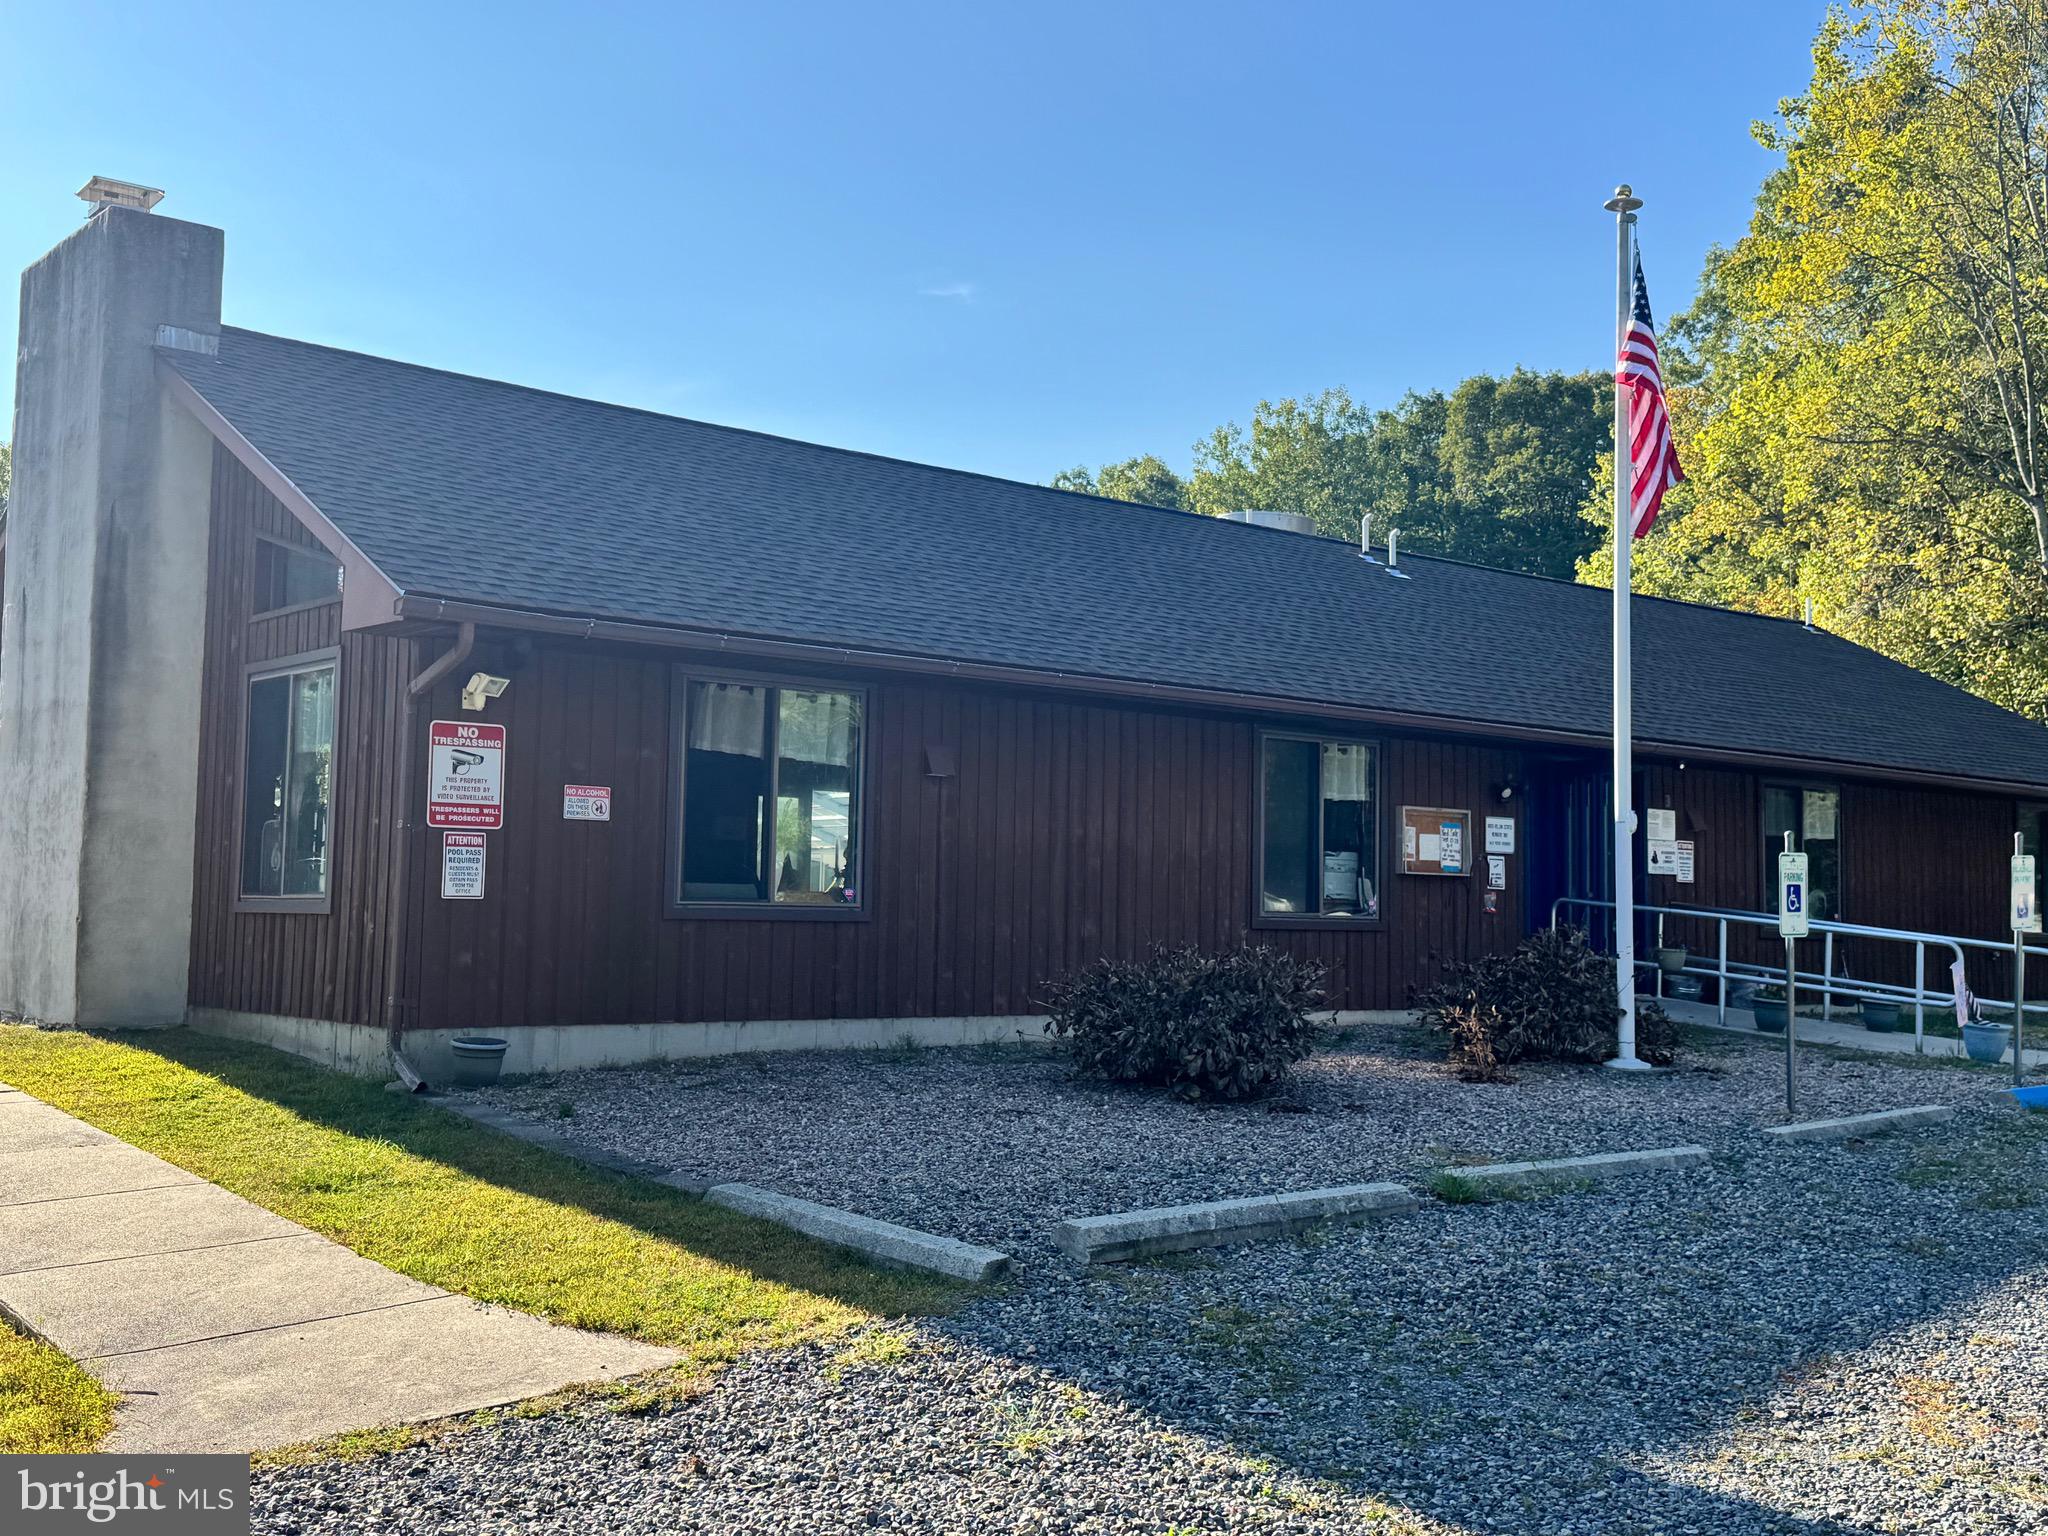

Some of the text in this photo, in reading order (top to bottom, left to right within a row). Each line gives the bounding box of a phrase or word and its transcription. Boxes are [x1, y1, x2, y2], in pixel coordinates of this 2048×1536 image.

[457, 726, 479, 739] NO
[433, 736, 502, 748] TRESPASSING
[445, 776, 488, 785] THIS PROPERTY
[449, 785, 481, 793] PROTECTED
[577, 789, 609, 798] ALCOHOL
[455, 794, 495, 802] SURVEILLANCE
[431, 806, 480, 814] TRESPASSERS
[448, 815, 495, 823] PROSECUTED
[447, 835, 483, 846] ATTENTION
[447, 848, 465, 856] POOL
[448, 856, 481, 865] REQUIRED
[1783, 872, 1804, 882] PARKING
